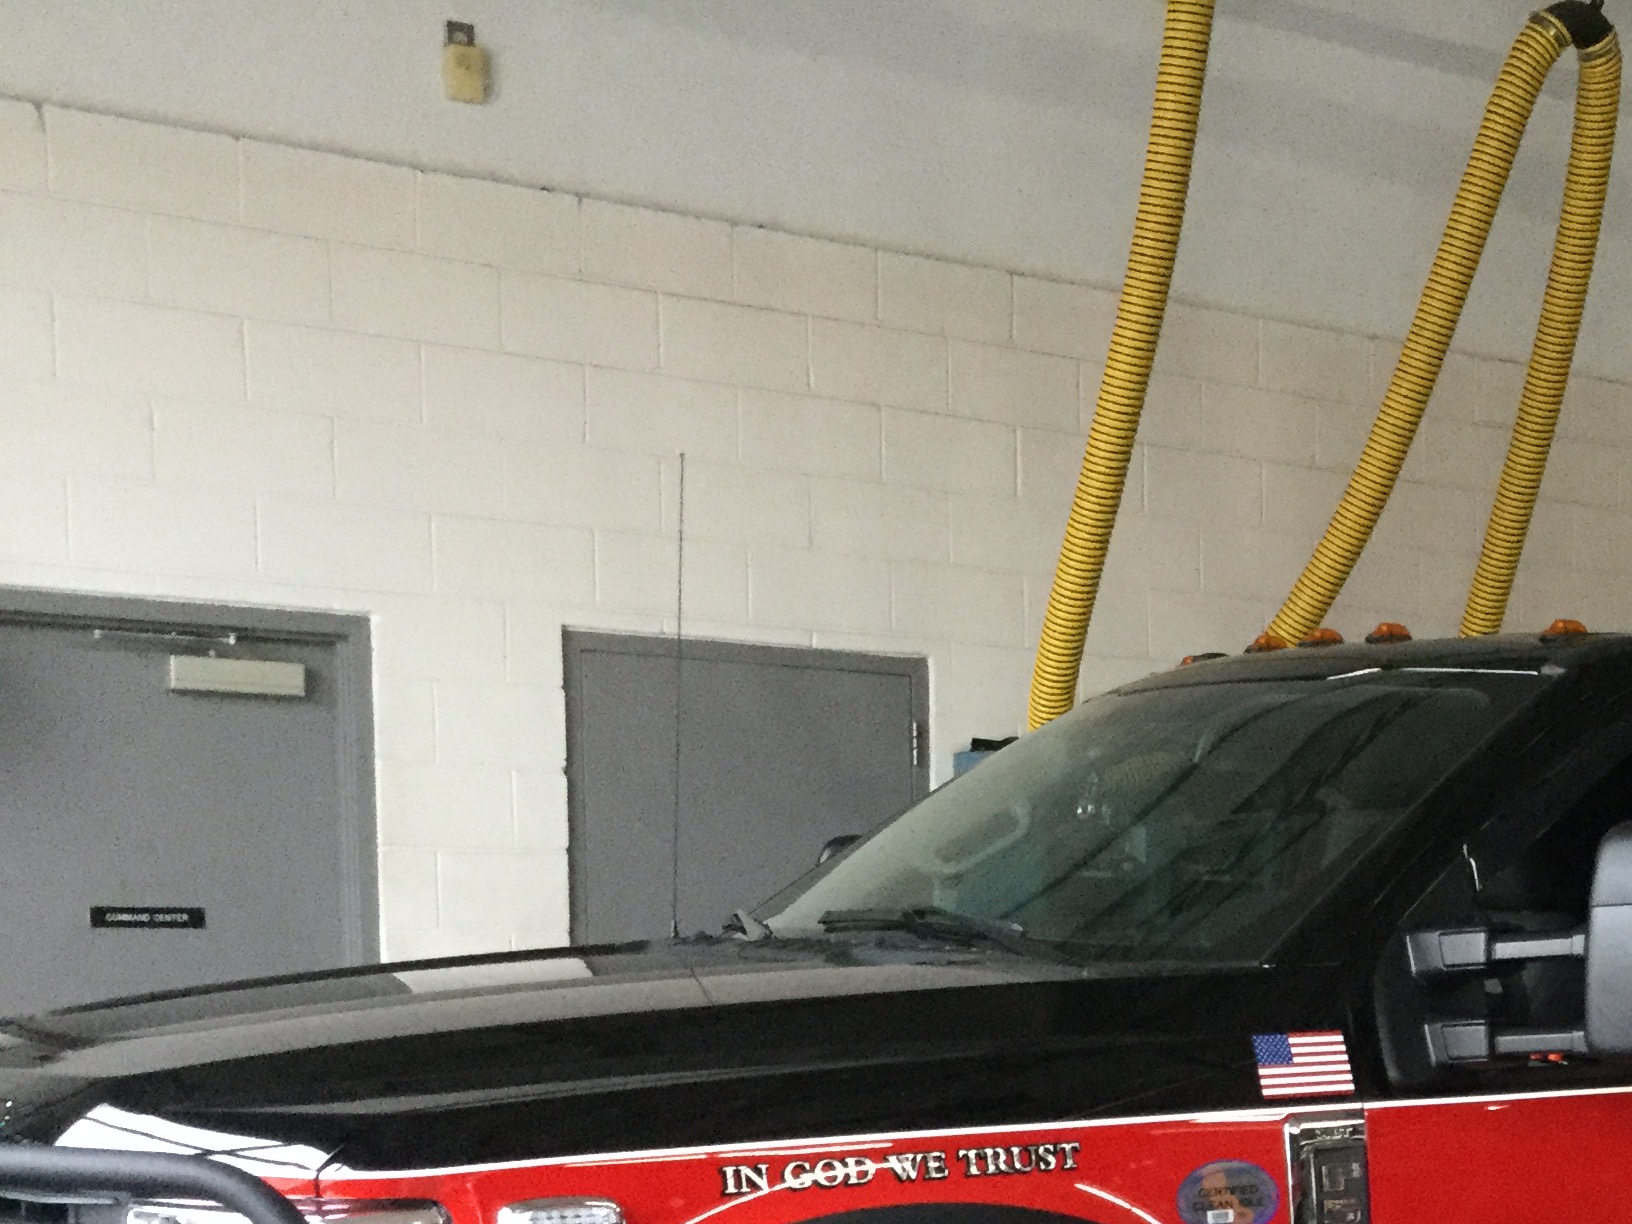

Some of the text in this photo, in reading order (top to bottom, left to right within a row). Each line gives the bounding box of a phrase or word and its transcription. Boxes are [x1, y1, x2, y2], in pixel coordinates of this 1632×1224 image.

[721, 1142, 1081, 1198] IN GOD WE TRUST
